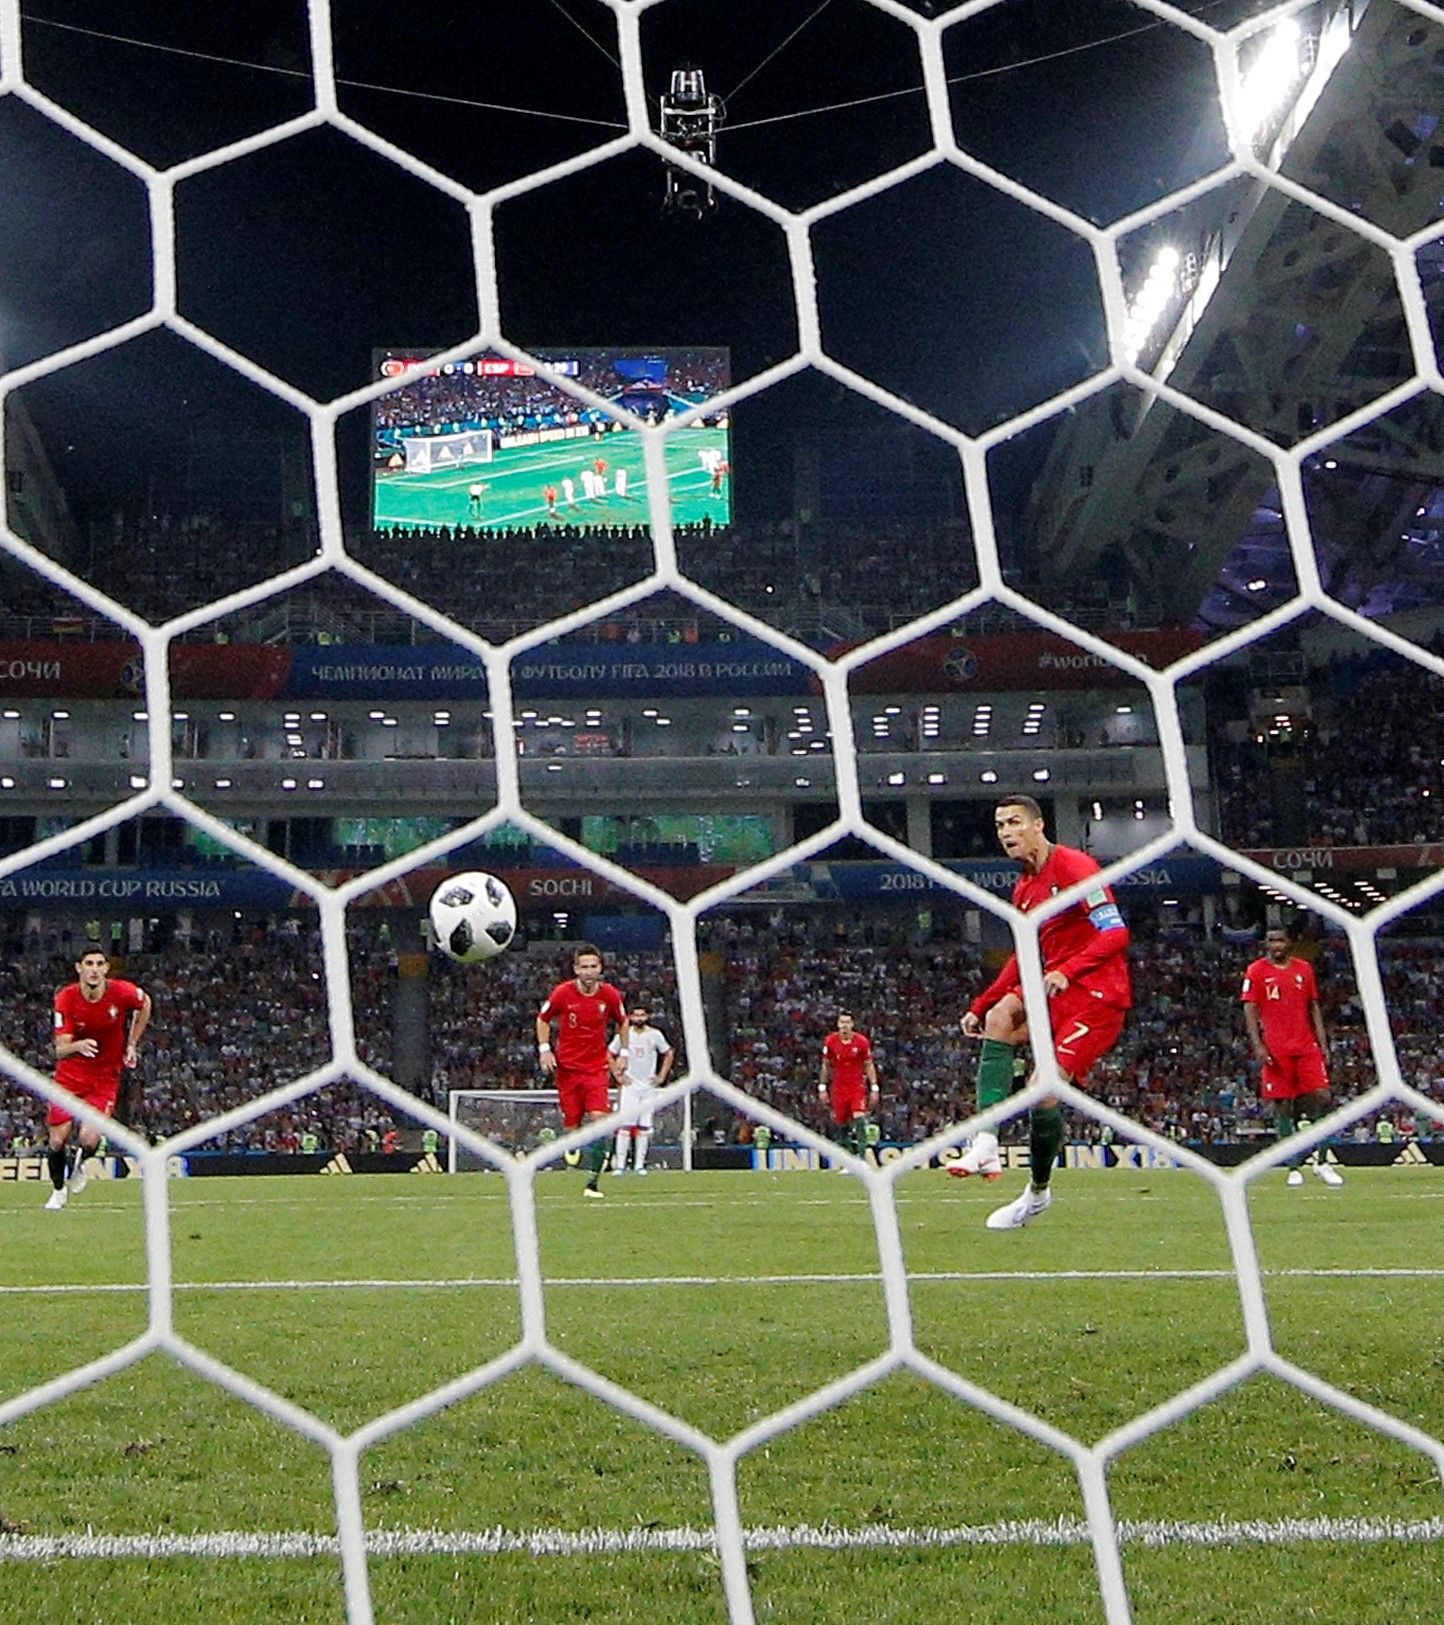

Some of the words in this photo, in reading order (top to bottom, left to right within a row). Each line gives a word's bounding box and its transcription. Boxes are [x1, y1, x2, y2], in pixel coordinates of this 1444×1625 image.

[431, 665, 485, 680] МИРА
[653, 663, 696, 679] 2018
[1273, 850, 1334, 869] СОЧИ
[22, 879, 95, 897] WORLD
[98, 879, 142, 897] CUP
[145, 879, 221, 897] RUSSIA
[529, 878, 593, 896] SOCHI
[880, 873, 925, 890] 2018
[1064, 1144, 1103, 1168] IN
